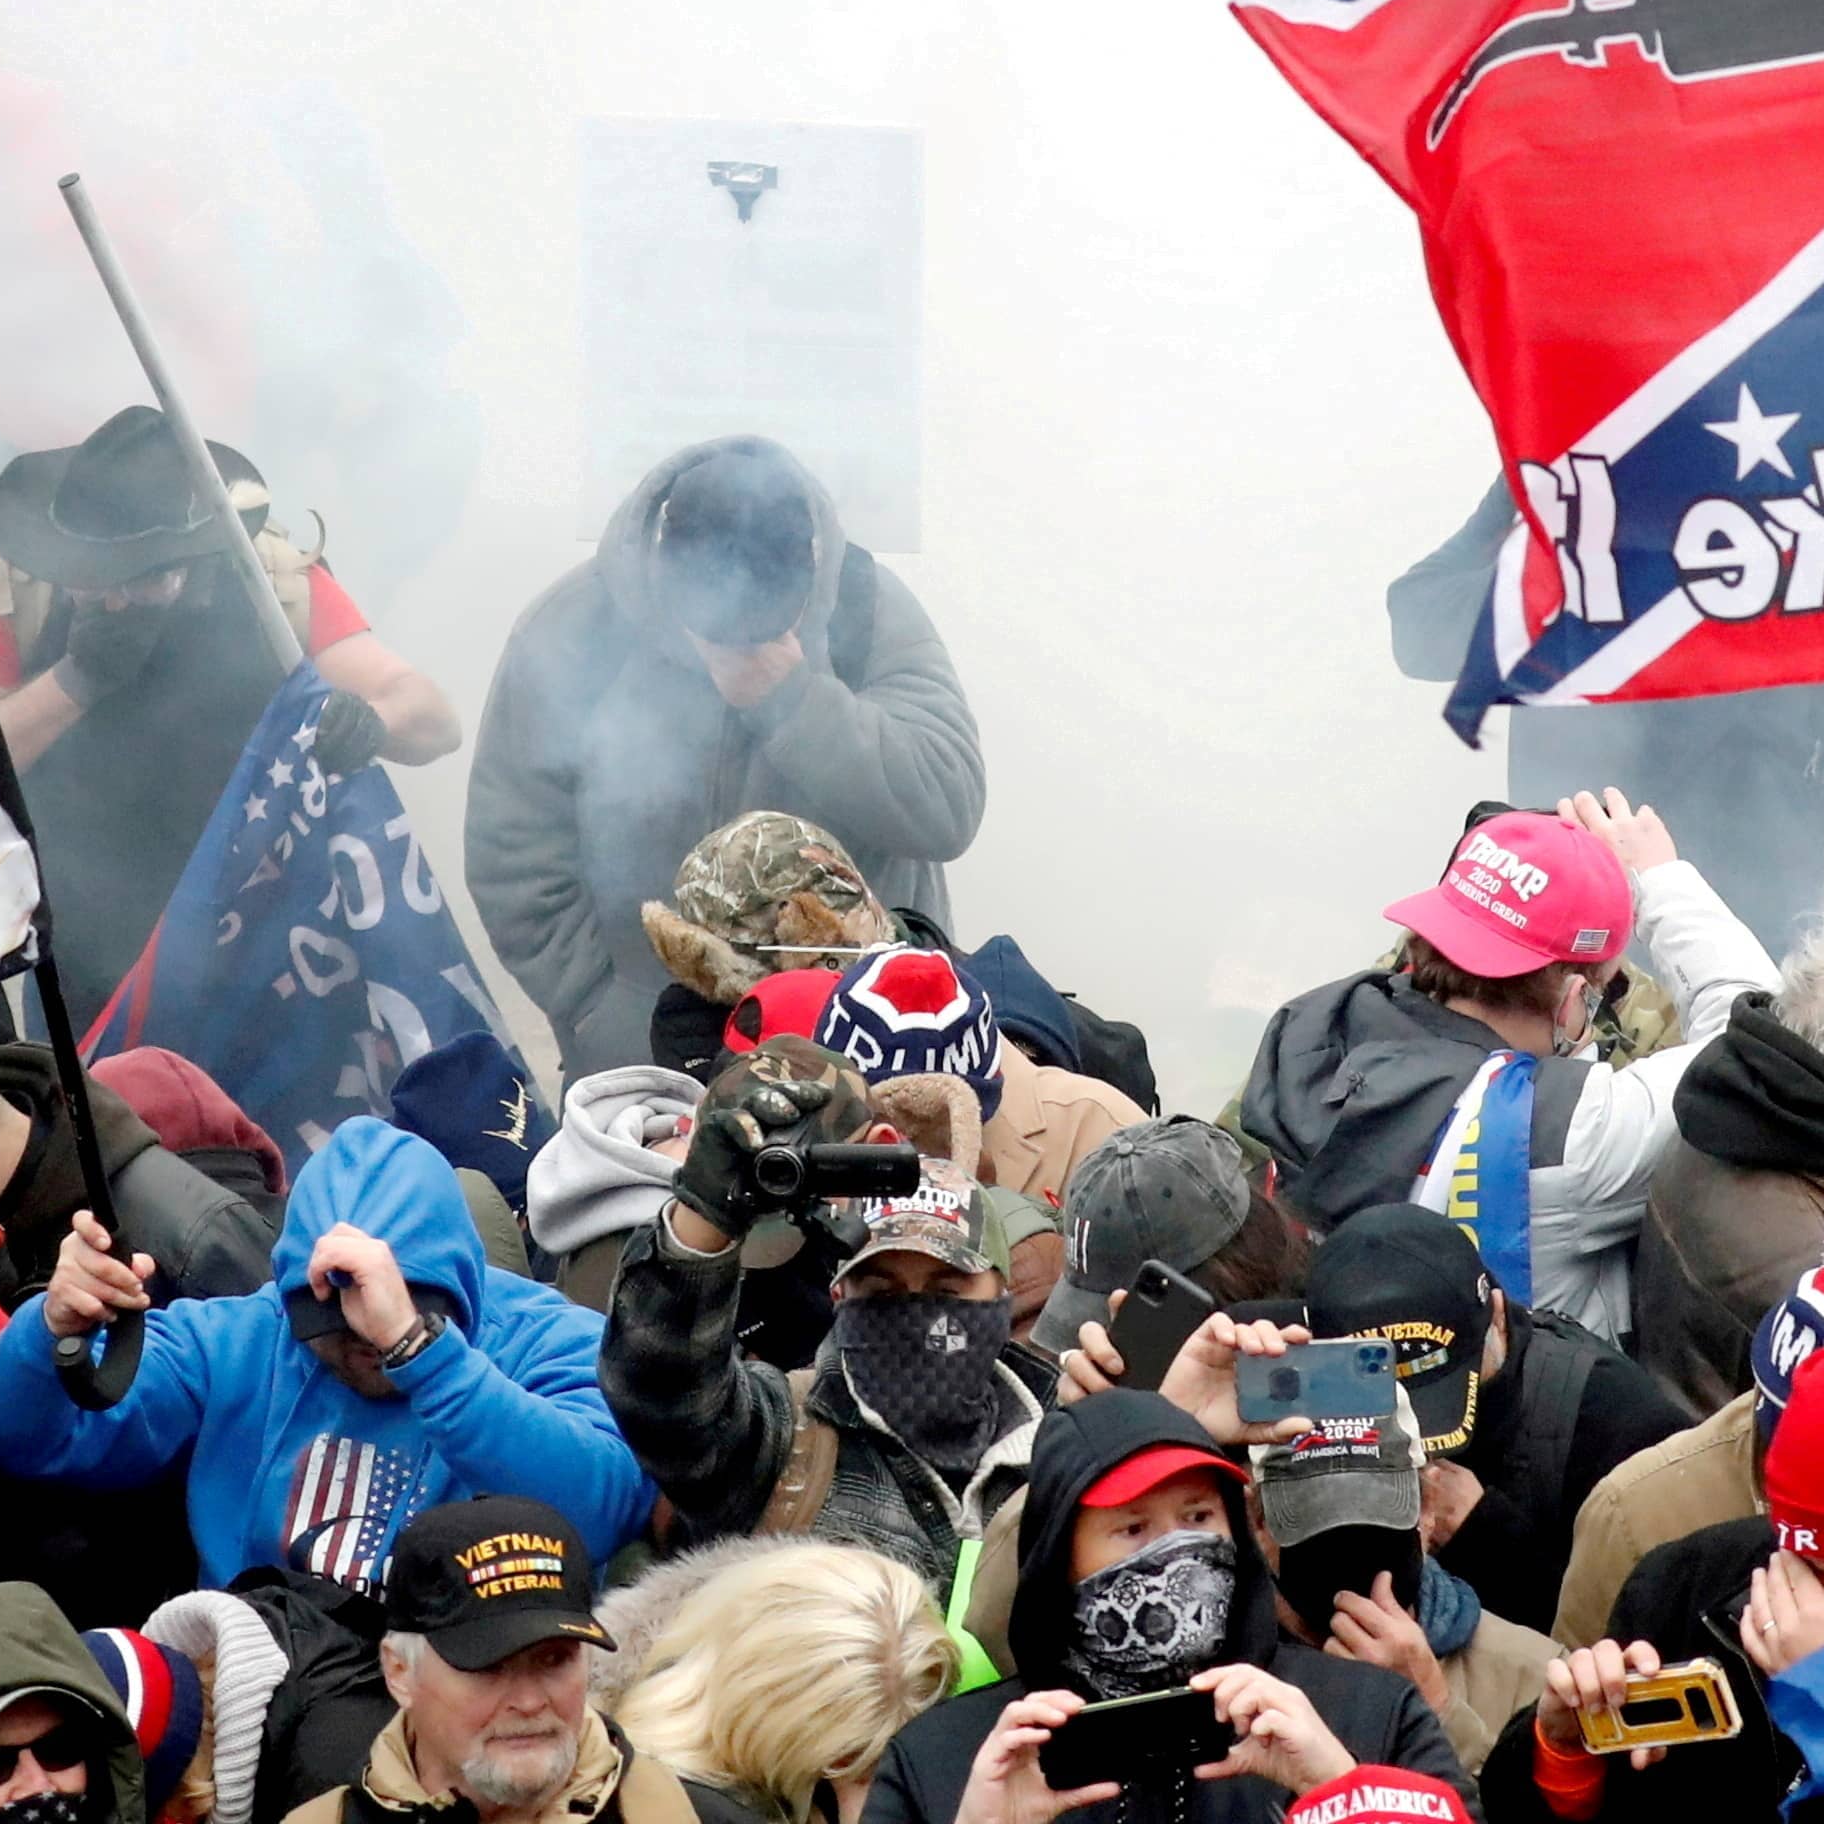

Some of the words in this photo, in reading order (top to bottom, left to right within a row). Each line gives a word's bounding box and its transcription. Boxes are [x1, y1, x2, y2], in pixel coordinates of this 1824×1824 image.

[1459, 831, 1549, 903] TRUMP
[1471, 865, 1502, 895] 2020
[1459, 873, 1494, 911] AMERICA
[1492, 902, 1528, 931] GREAT!
[1383, 1322, 1455, 1345] VETERAN
[1420, 1428, 1468, 1454] IETNAM
[1462, 1370, 1480, 1432] VETERAN
[1323, 1425, 1364, 1440] 2020
[1312, 1445, 1348, 1458] AMERICA
[1350, 1444, 1381, 1459] GREAT!
[456, 1532, 564, 1569] VIETNAM
[475, 1575, 563, 1599] VETERAN
[1348, 1785, 1456, 1823] AMERICA
